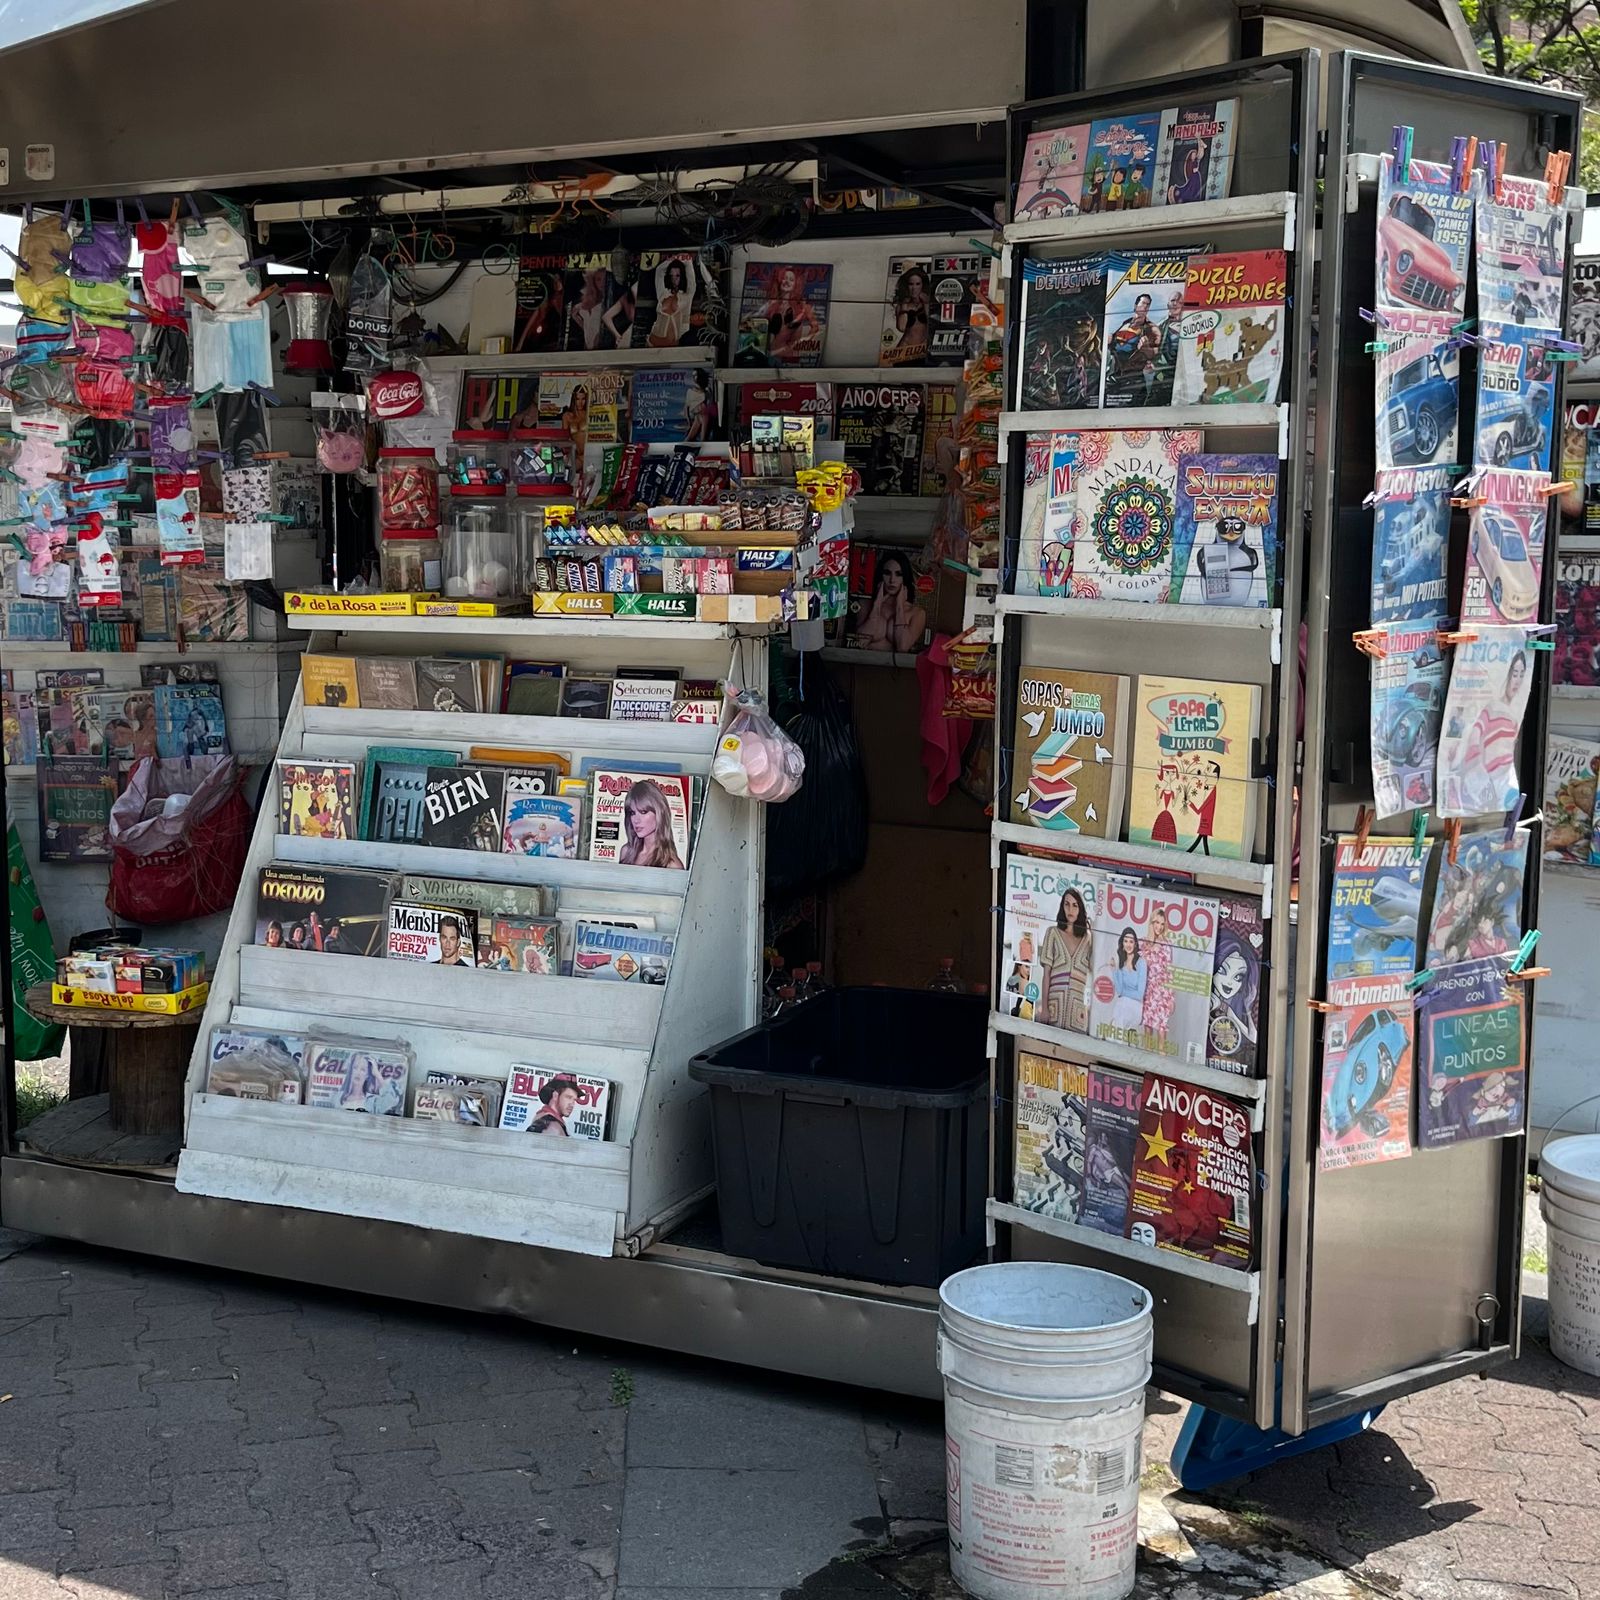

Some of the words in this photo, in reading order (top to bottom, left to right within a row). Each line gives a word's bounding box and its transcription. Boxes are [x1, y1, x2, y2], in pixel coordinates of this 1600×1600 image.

[1166, 121, 1225, 140] MANDALAS
[1410, 190, 1449, 208] PICK
[1450, 194, 1473, 211] UP
[1430, 208, 1470, 220] CHEVROLET
[1438, 217, 1469, 232] CAMEO
[1436, 229, 1468, 246] 1955
[1052, 265, 1088, 274] BATMAN
[1187, 265, 1245, 288] PUZLE
[1035, 269, 1101, 291] DETECTIVE
[1206, 276, 1286, 305] JAPONÉS
[1182, 317, 1214, 337] SUDOKUS
[639, 371, 687, 383] PLAYBOY
[1481, 375, 1520, 392] AUDIO
[496, 378, 520, 420] H
[637, 399, 668, 409] Resorts
[799, 398, 834, 414] 2004
[841, 386, 923, 409] AÑO/CERO
[588, 414, 611, 424] TINA
[636, 417, 665, 431] 2003
[1088, 457, 1177, 496] MANDALA
[1185, 466, 1277, 498] SUDOKU
[1192, 496, 1272, 527] EXTRA
[741, 550, 776, 561] HALLS
[749, 560, 768, 569] mini
[1088, 557, 1113, 585] PARA
[568, 561, 584, 592] SNICK
[586, 561, 600, 592] SNICK
[1467, 578, 1487, 598] 250
[309, 598, 326, 611] de
[327, 598, 341, 612] la
[343, 599, 377, 612] Rosa
[565, 596, 605, 610] HALLS
[647, 598, 688, 612] HALLS
[614, 682, 673, 697] Selecciones
[1021, 679, 1064, 708] SOPAS
[1072, 692, 1102, 710] LETRAS
[613, 700, 671, 712] ADICCIONES:
[1168, 698, 1206, 718] SOPA
[622, 711, 635, 719] LOS
[635, 711, 660, 719] NUEVOS
[1050, 708, 1105, 738] JUMBO
[1174, 702, 1220, 732] LETRAS
[1169, 738, 1215, 750] JUMBO
[54, 788, 105, 801] LINEAS
[424, 770, 491, 826] BIEN
[596, 796, 624, 807] Taylor
[55, 809, 105, 820] PUNTOS
[596, 805, 624, 814] SWIFT
[265, 869, 278, 879] Una
[278, 872, 302, 882] aventura
[301, 873, 326, 884] llamada
[261, 881, 326, 903] MENUDO
[422, 880, 474, 897] VARIOS
[1335, 887, 1374, 907] B-747-8
[1106, 883, 1215, 938] burda
[393, 908, 431, 935] Men's
[389, 932, 438, 946] CONSTRUYE
[1166, 930, 1212, 957] easy
[388, 941, 429, 956] FUERZA
[1464, 991, 1485, 1003] CON
[1441, 1009, 1509, 1040] LINEAS
[1442, 1044, 1507, 1071] PUNTOS
[513, 1066, 535, 1075] WORLD'S
[506, 1104, 528, 1114] KEN
[579, 1110, 603, 1124] HOT
[1145, 1078, 1248, 1139] AÑO/CERO
[573, 1121, 601, 1138] TIMES
[1211, 1135, 1219, 1144] LA
[1181, 1132, 1249, 1165] CONSPIRACIÓN
[1206, 1150, 1250, 1179] CHINA
[1196, 1162, 1250, 1192] DOMINAR
[1196, 1174, 1210, 1188] EL
